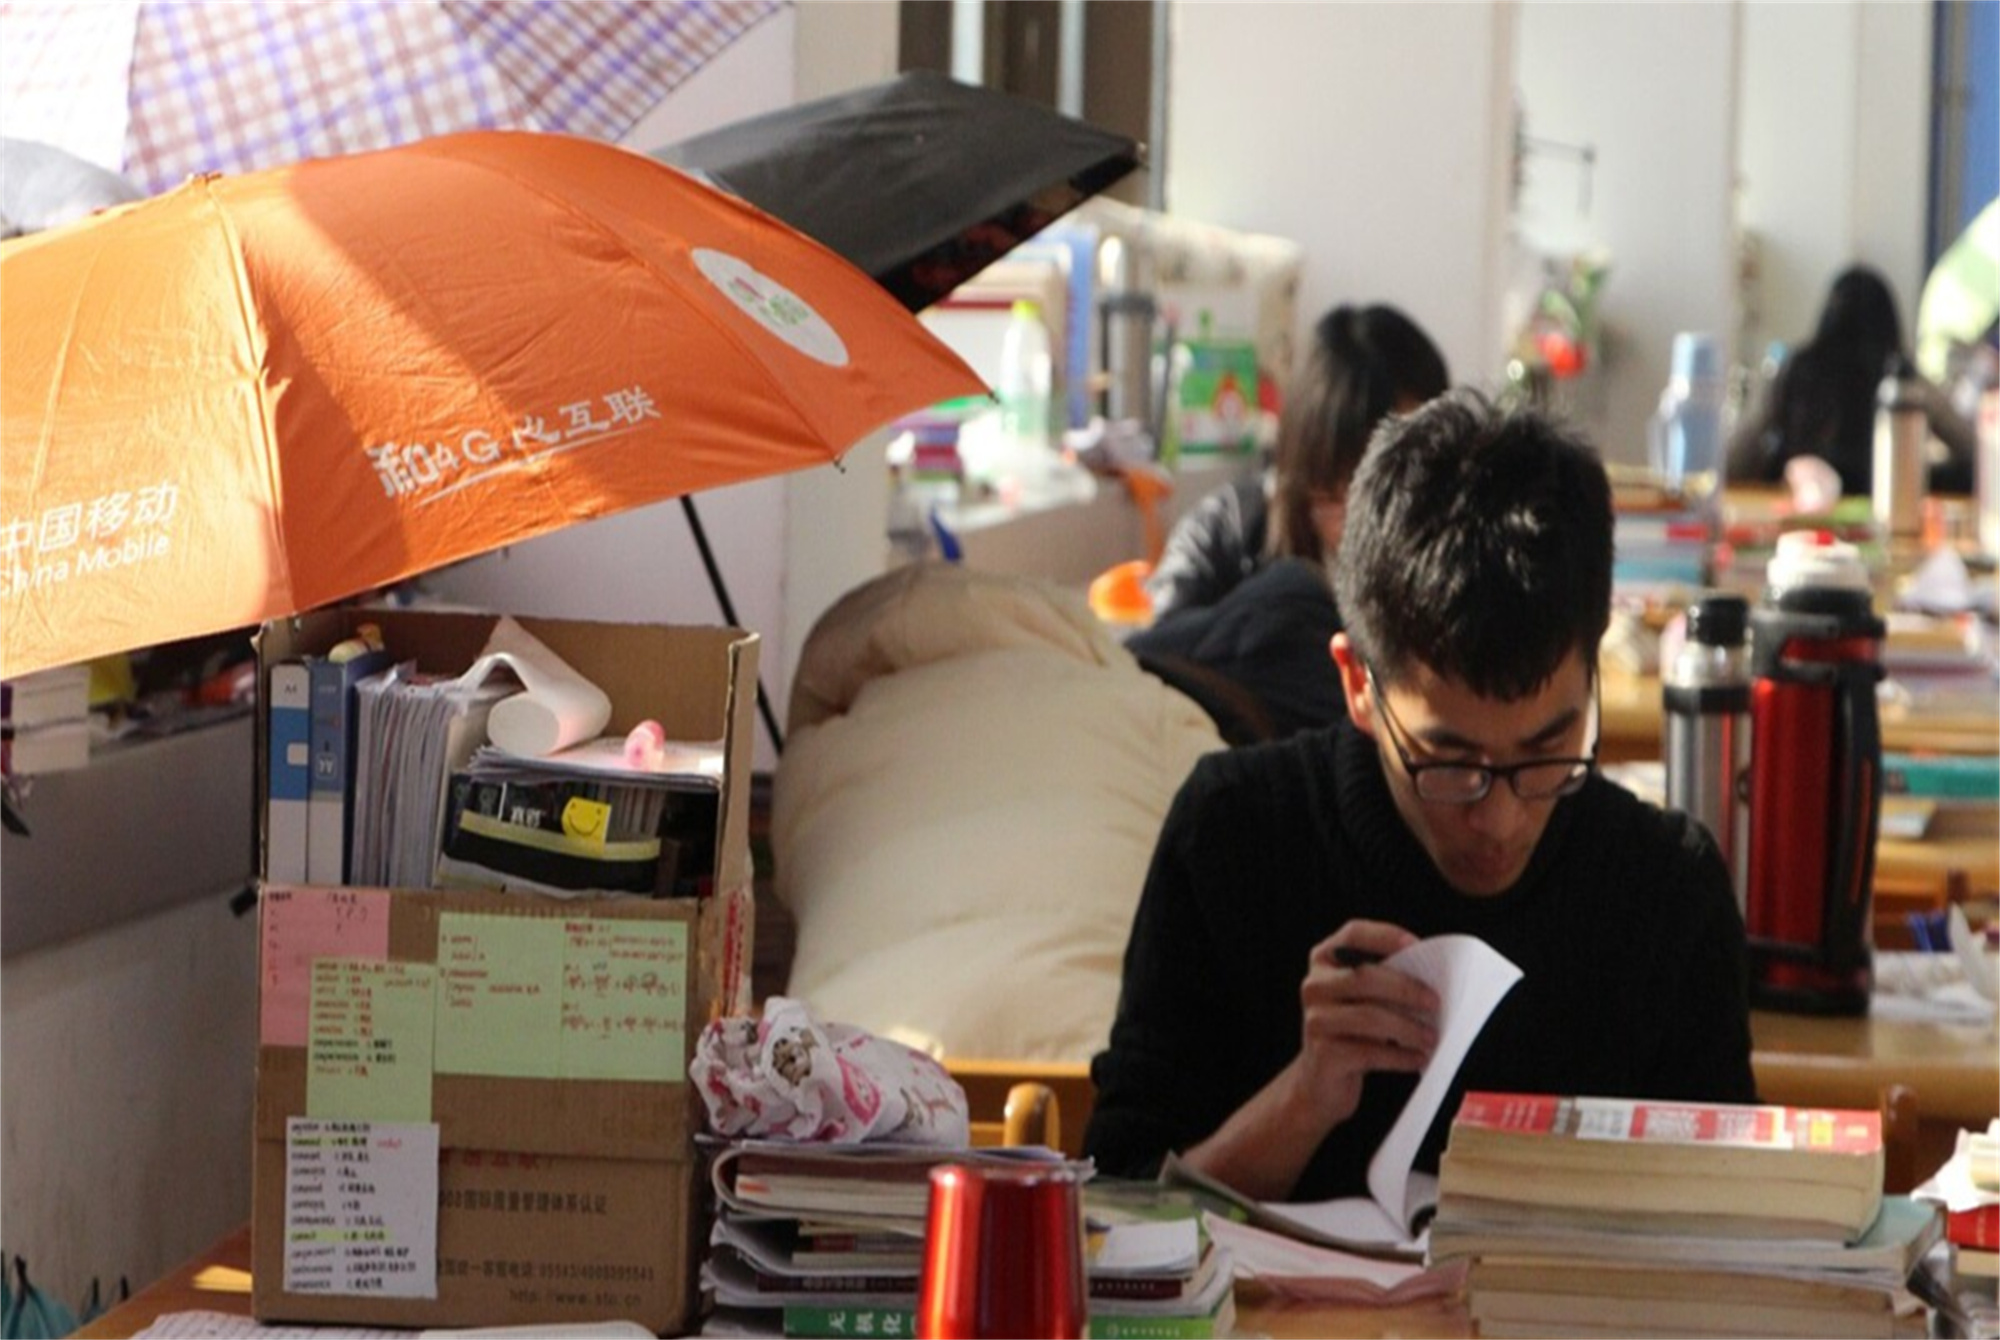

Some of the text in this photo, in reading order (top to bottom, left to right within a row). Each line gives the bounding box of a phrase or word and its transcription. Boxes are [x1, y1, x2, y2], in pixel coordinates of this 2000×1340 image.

[0, 480, 179, 563] 中国移动
[75, 533, 170, 578] Mobile
[827, 1310, 917, 1336] 无机化
